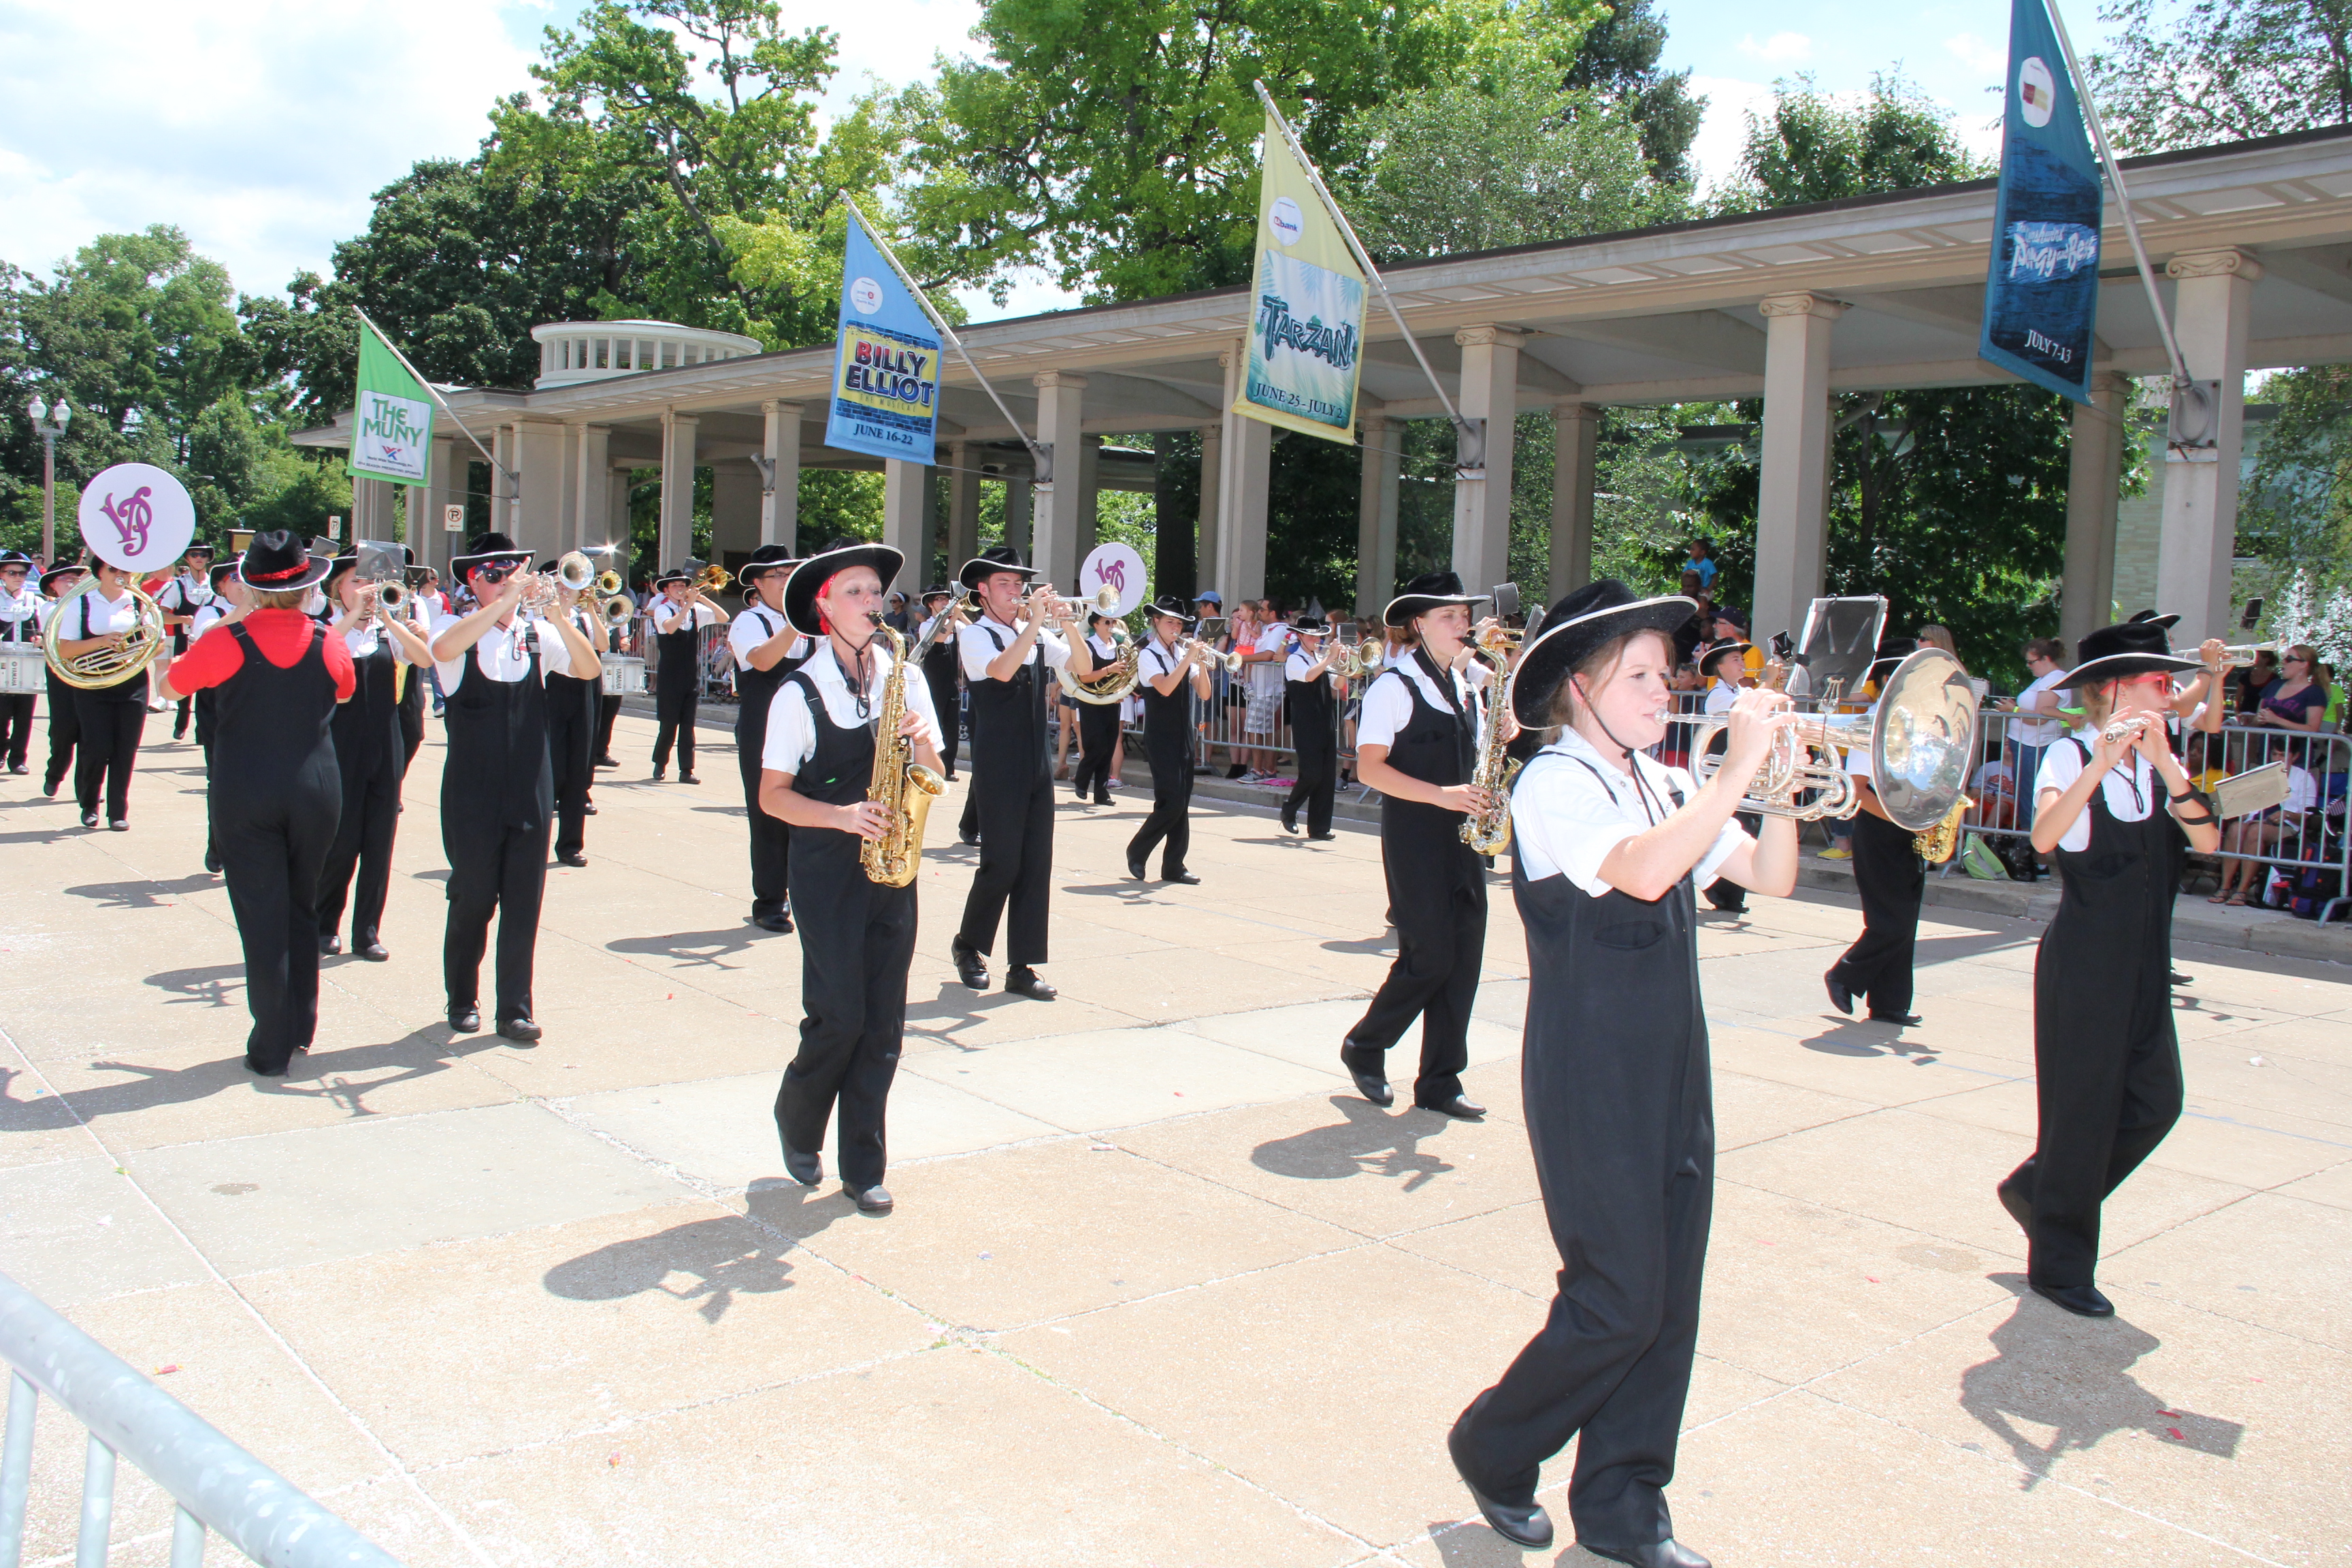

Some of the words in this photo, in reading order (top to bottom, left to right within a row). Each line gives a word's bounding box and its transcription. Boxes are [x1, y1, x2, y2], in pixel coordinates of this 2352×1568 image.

[855, 340, 927, 378] BILLY
[2024, 329, 2052, 353] JULY
[2052, 342, 2072, 363] 7-13
[845, 363, 934, 406] ELLIOT
[1254, 382, 1286, 402] JUNE
[1288, 393, 1300, 407] 25
[1307, 399, 1336, 416] JULY
[1337, 408, 1343, 419] 2
[372, 398, 408, 425] THE
[860, 393, 874, 404] THE
[880, 399, 916, 412] MUSICAL
[363, 417, 425, 447] MUNY
[853, 423, 883, 439] JUNE
[886, 431, 913, 444] 16-22
